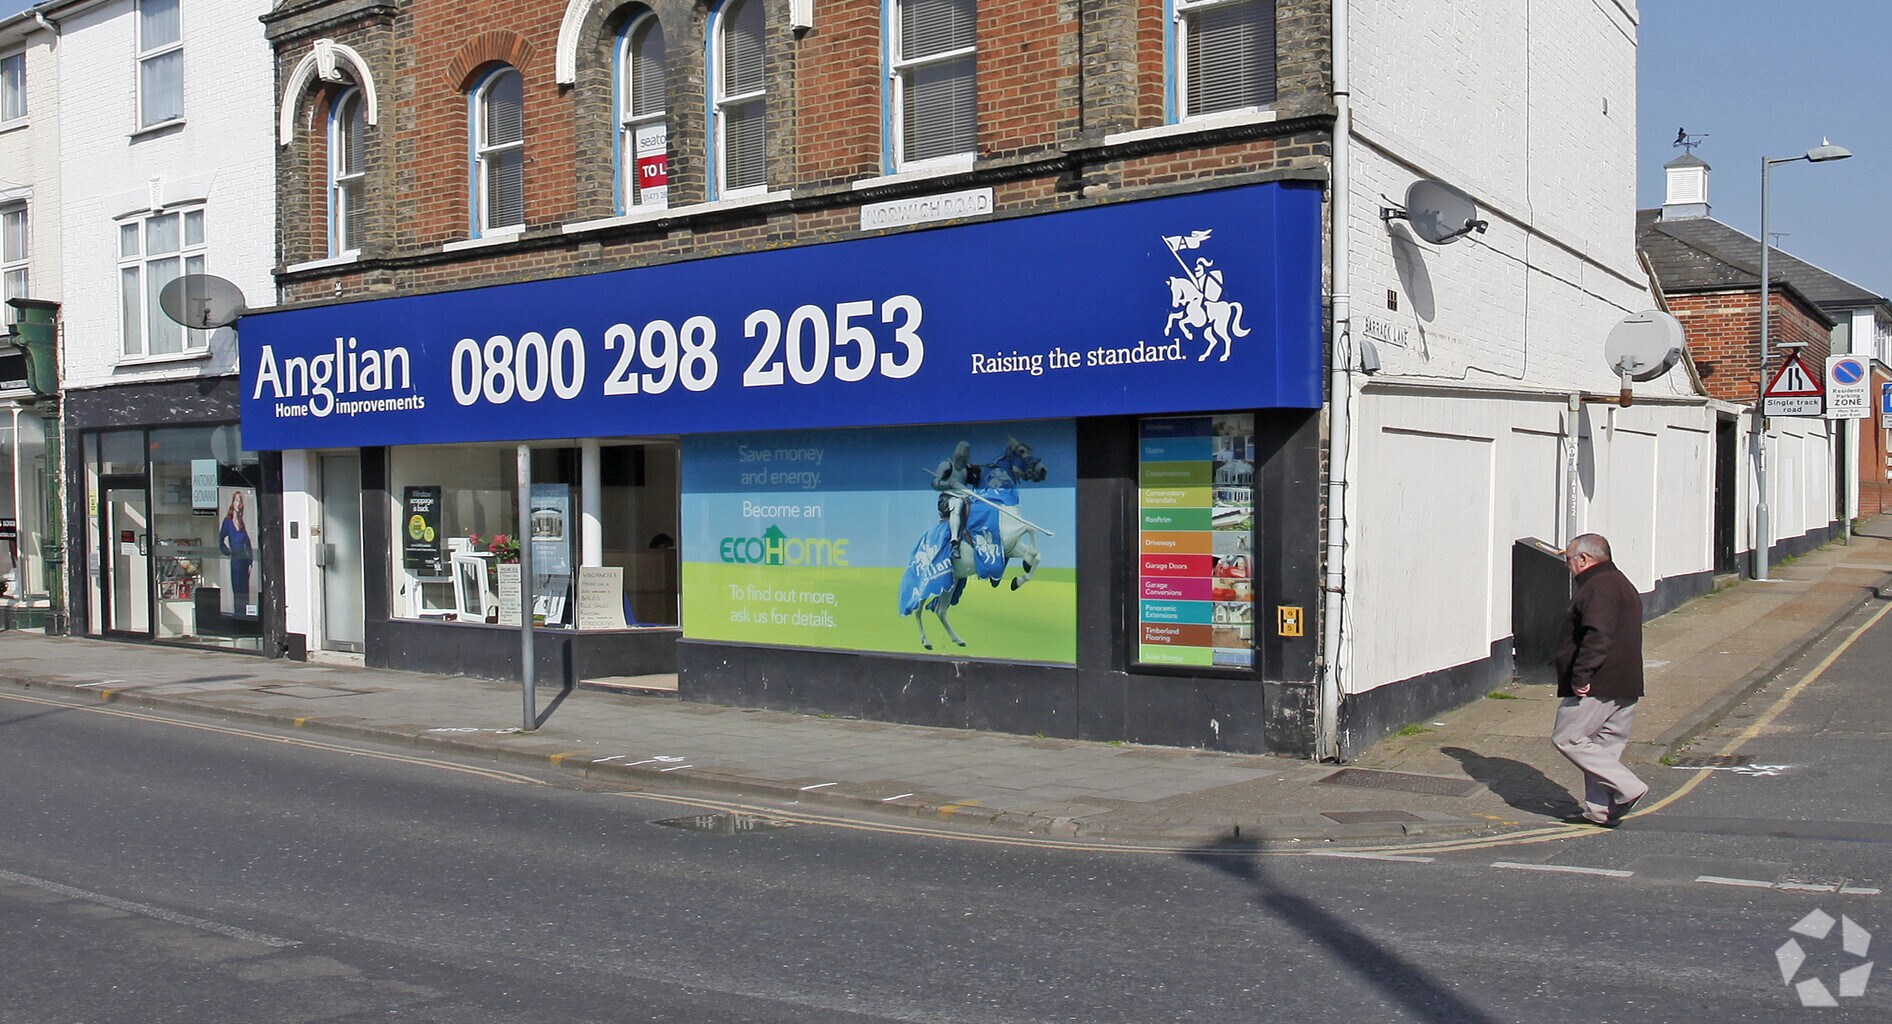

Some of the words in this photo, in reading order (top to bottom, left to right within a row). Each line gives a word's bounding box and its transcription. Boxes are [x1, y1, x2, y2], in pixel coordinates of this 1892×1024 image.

[642, 164, 657, 177] TO
[867, 200, 940, 225] NORWICH
[944, 195, 987, 215] ROAD
[451, 328, 586, 406] 0800
[603, 315, 718, 396] 298
[743, 294, 925, 387] 2053
[971, 351, 1043, 376] Raising
[1048, 347, 1081, 369] the
[1087, 338, 1187, 366] standard.
[252, 337, 411, 417] Anglian
[275, 403, 308, 418] Home
[336, 395, 425, 416] improvements
[738, 445, 771, 462] Save
[775, 447, 824, 465] money
[741, 467, 767, 485] and
[771, 471, 821, 488] energy.
[1145, 489, 1185, 497] Conservatory
[743, 501, 800, 517] Become
[804, 505, 821, 517] an
[1145, 539, 1176, 547] Driveways
[1145, 562, 1168, 571] Garage
[729, 583, 744, 600] To
[747, 584, 772, 601] find
[775, 589, 796, 602] out
[800, 591, 838, 607] more,
[1145, 581, 1168, 589] Garage
[731, 606, 751, 622] ask
[754, 612, 767, 623] us
[771, 607, 788, 624] for
[791, 610, 837, 627] details.
[1145, 634, 1171, 643] Flooring
